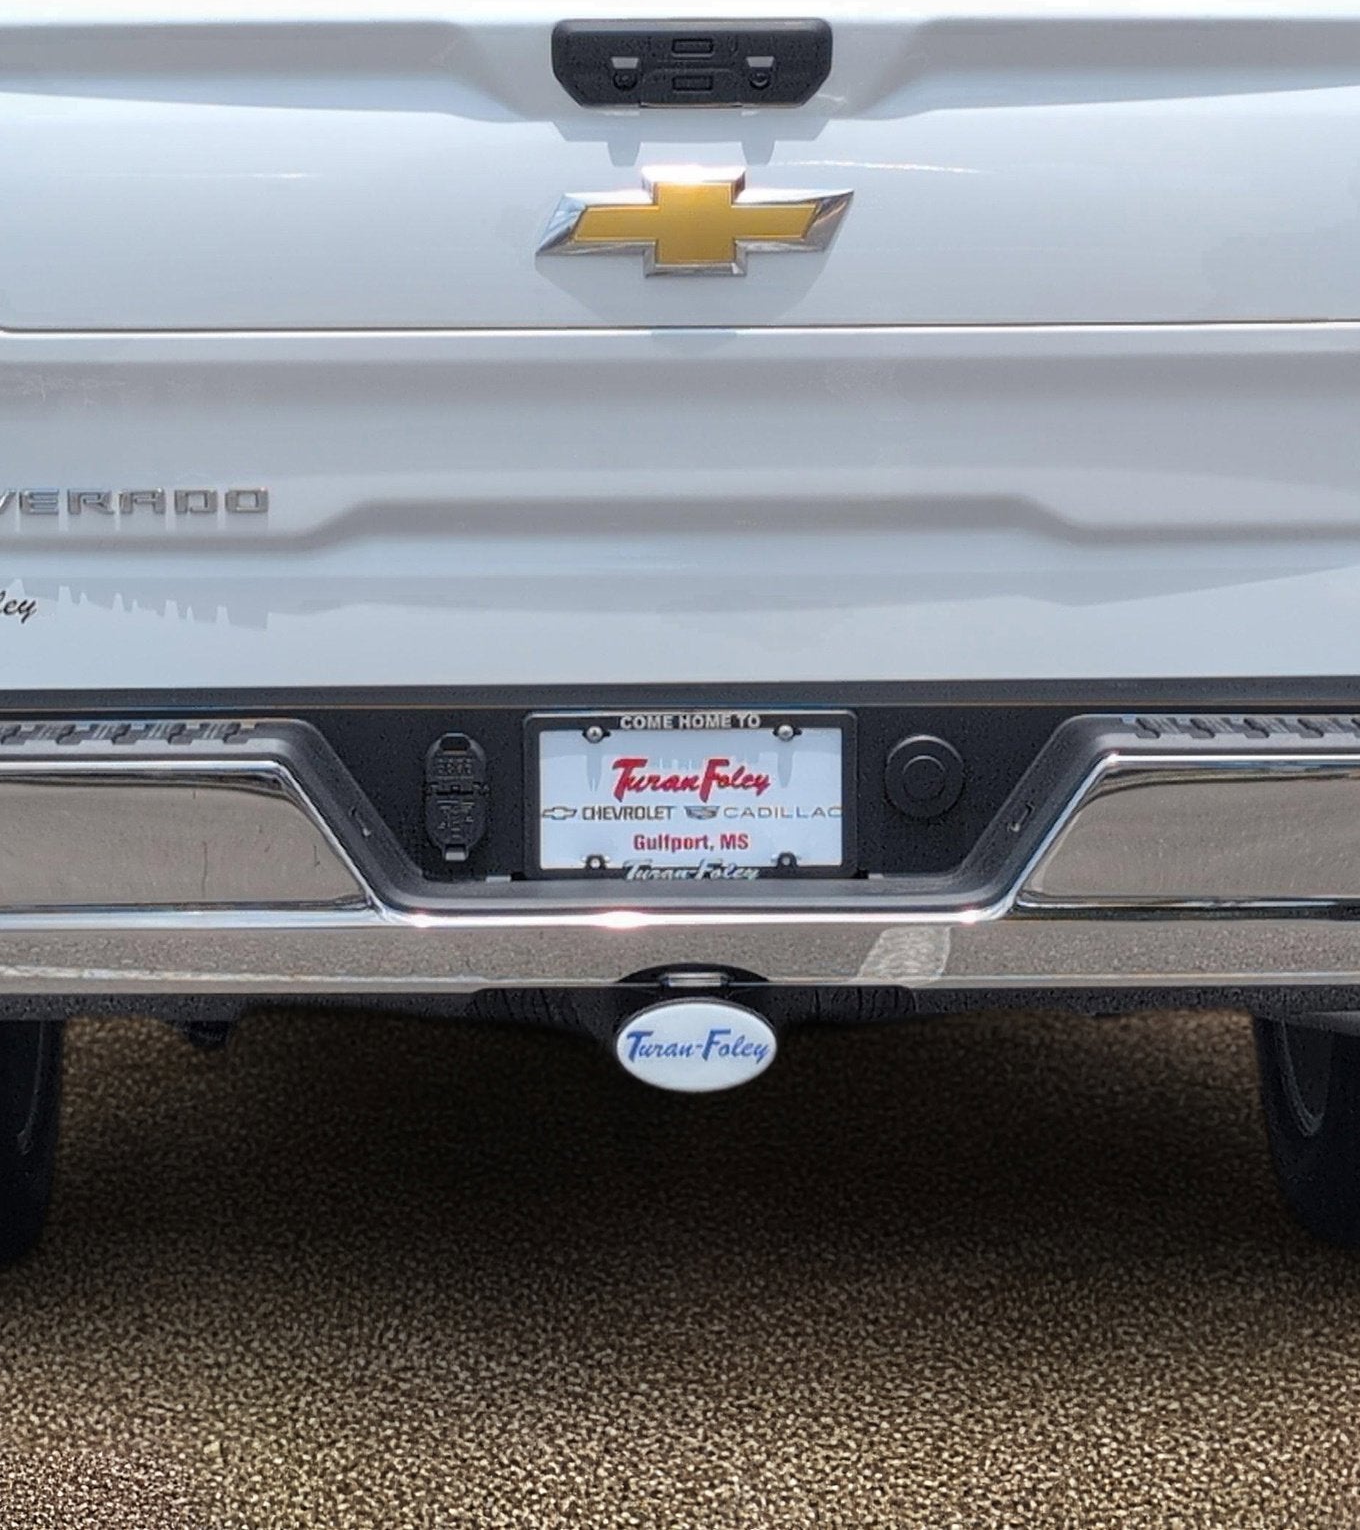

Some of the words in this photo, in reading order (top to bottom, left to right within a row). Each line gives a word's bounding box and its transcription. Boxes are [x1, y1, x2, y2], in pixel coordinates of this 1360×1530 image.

[620, 714, 674, 730] COME
[678, 713, 734, 729] HOME
[736, 713, 761, 728] TO
[581, 805, 676, 820] CHEVROLET
[723, 805, 843, 819] CADILLAC
[633, 833, 715, 853] Gulfport,
[720, 833, 749, 850] MS
[626, 1028, 770, 1064] Turan-Foley
